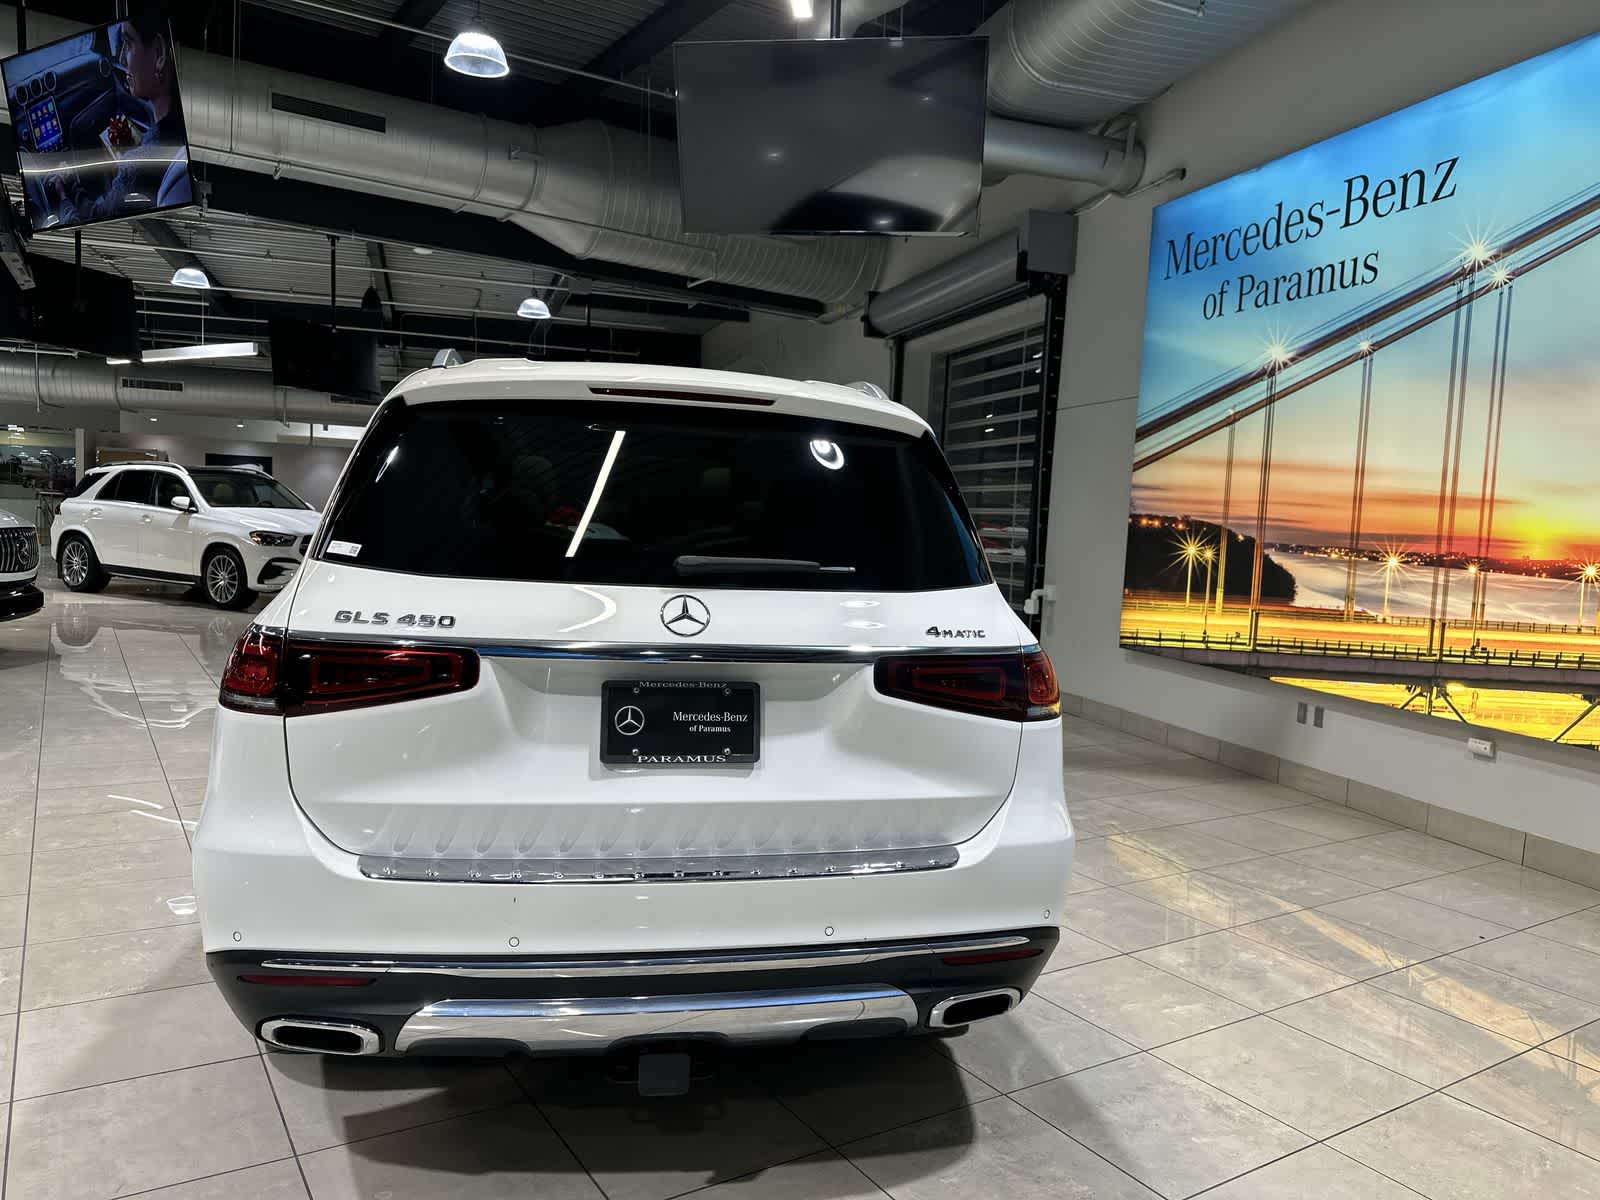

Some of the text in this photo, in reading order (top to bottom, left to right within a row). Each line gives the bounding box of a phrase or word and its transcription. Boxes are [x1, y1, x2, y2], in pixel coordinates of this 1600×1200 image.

[1163, 156, 1460, 281] Mercedes-Benz
[1202, 250, 1380, 321] of Paramus
[334, 610, 457, 629] GLS 450
[925, 626, 986, 639] 4MATIC
[639, 681, 728, 689] Mercedes-Benz
[672, 711, 749, 722] Mercedes-Benz
[689, 725, 732, 733] of Paramus
[637, 755, 727, 763] PARAMUS
